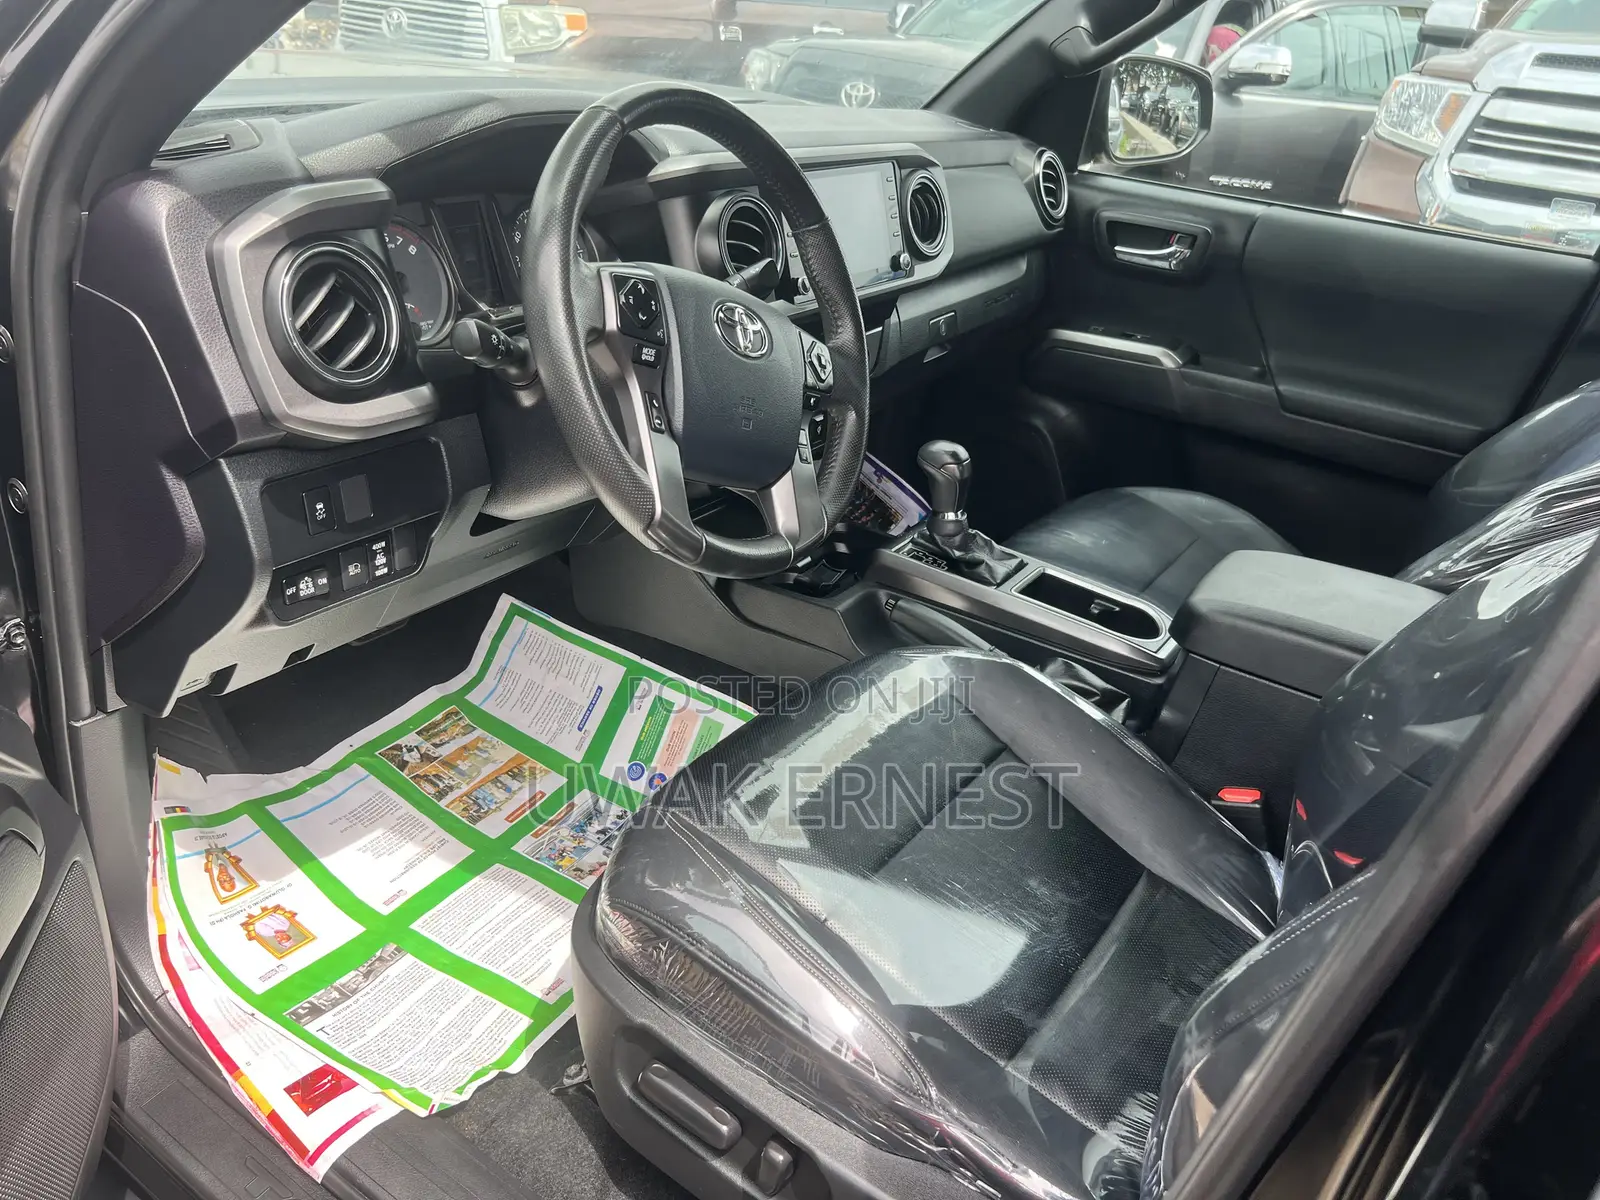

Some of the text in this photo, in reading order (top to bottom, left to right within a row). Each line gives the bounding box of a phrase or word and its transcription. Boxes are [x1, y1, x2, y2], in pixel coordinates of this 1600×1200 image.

[514, 232, 522, 244] 40
[408, 245, 417, 255] 8
[318, 577, 328, 585] ON
[286, 586, 297, 596] OFF
[300, 587, 315, 597] DOOR
